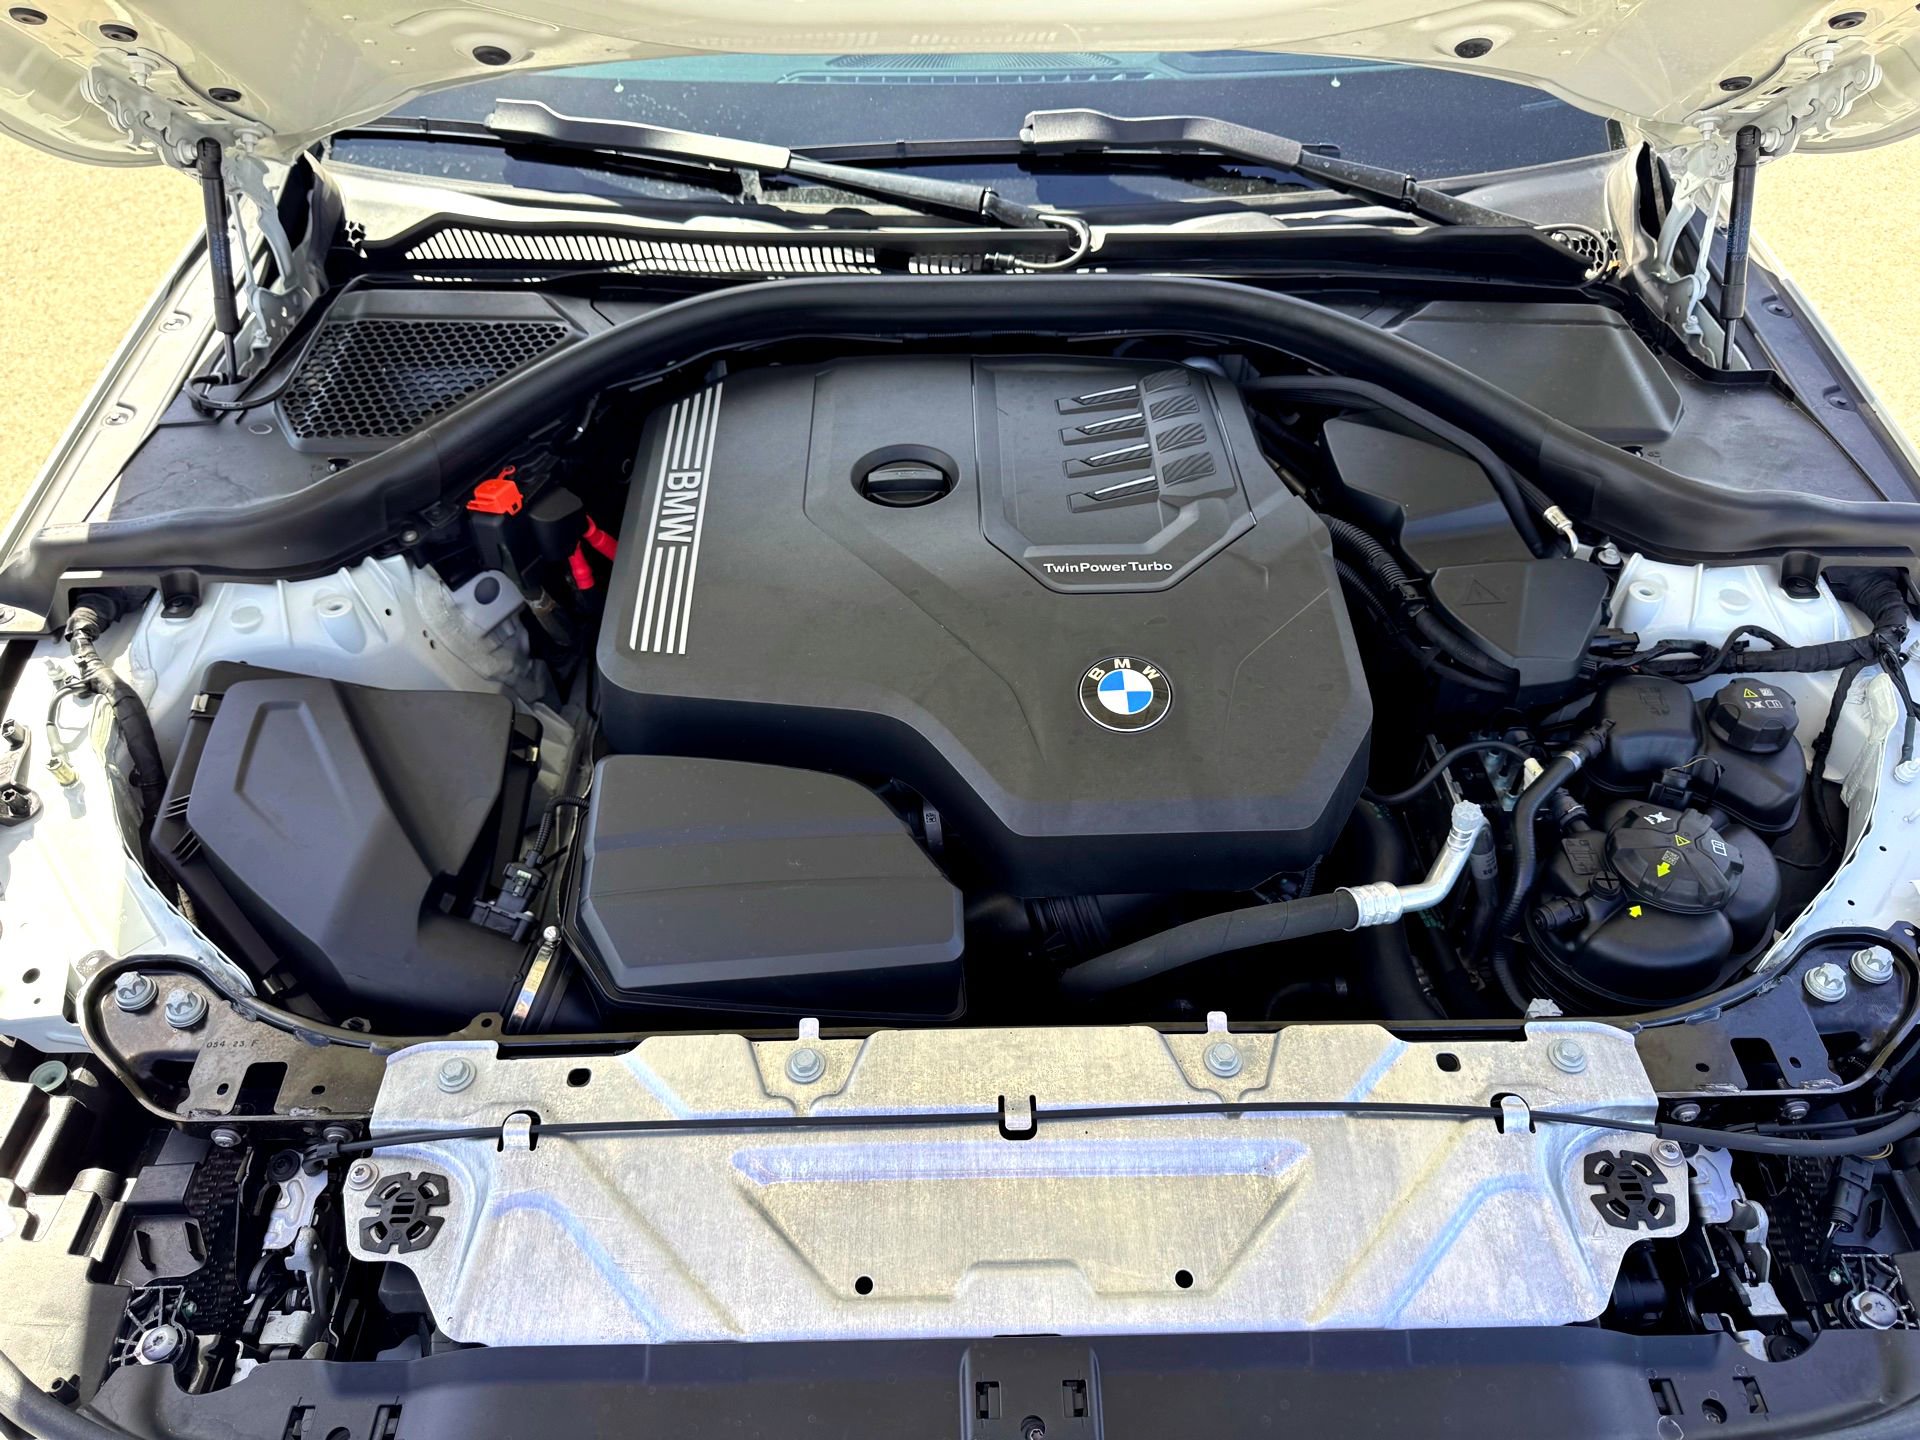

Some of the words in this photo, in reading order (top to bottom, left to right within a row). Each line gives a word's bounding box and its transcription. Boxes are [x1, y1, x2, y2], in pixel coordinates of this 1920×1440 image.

[657, 471, 701, 543] BMW
[1128, 561, 1173, 571] Turbo
[1088, 658, 1160, 681] BMW
